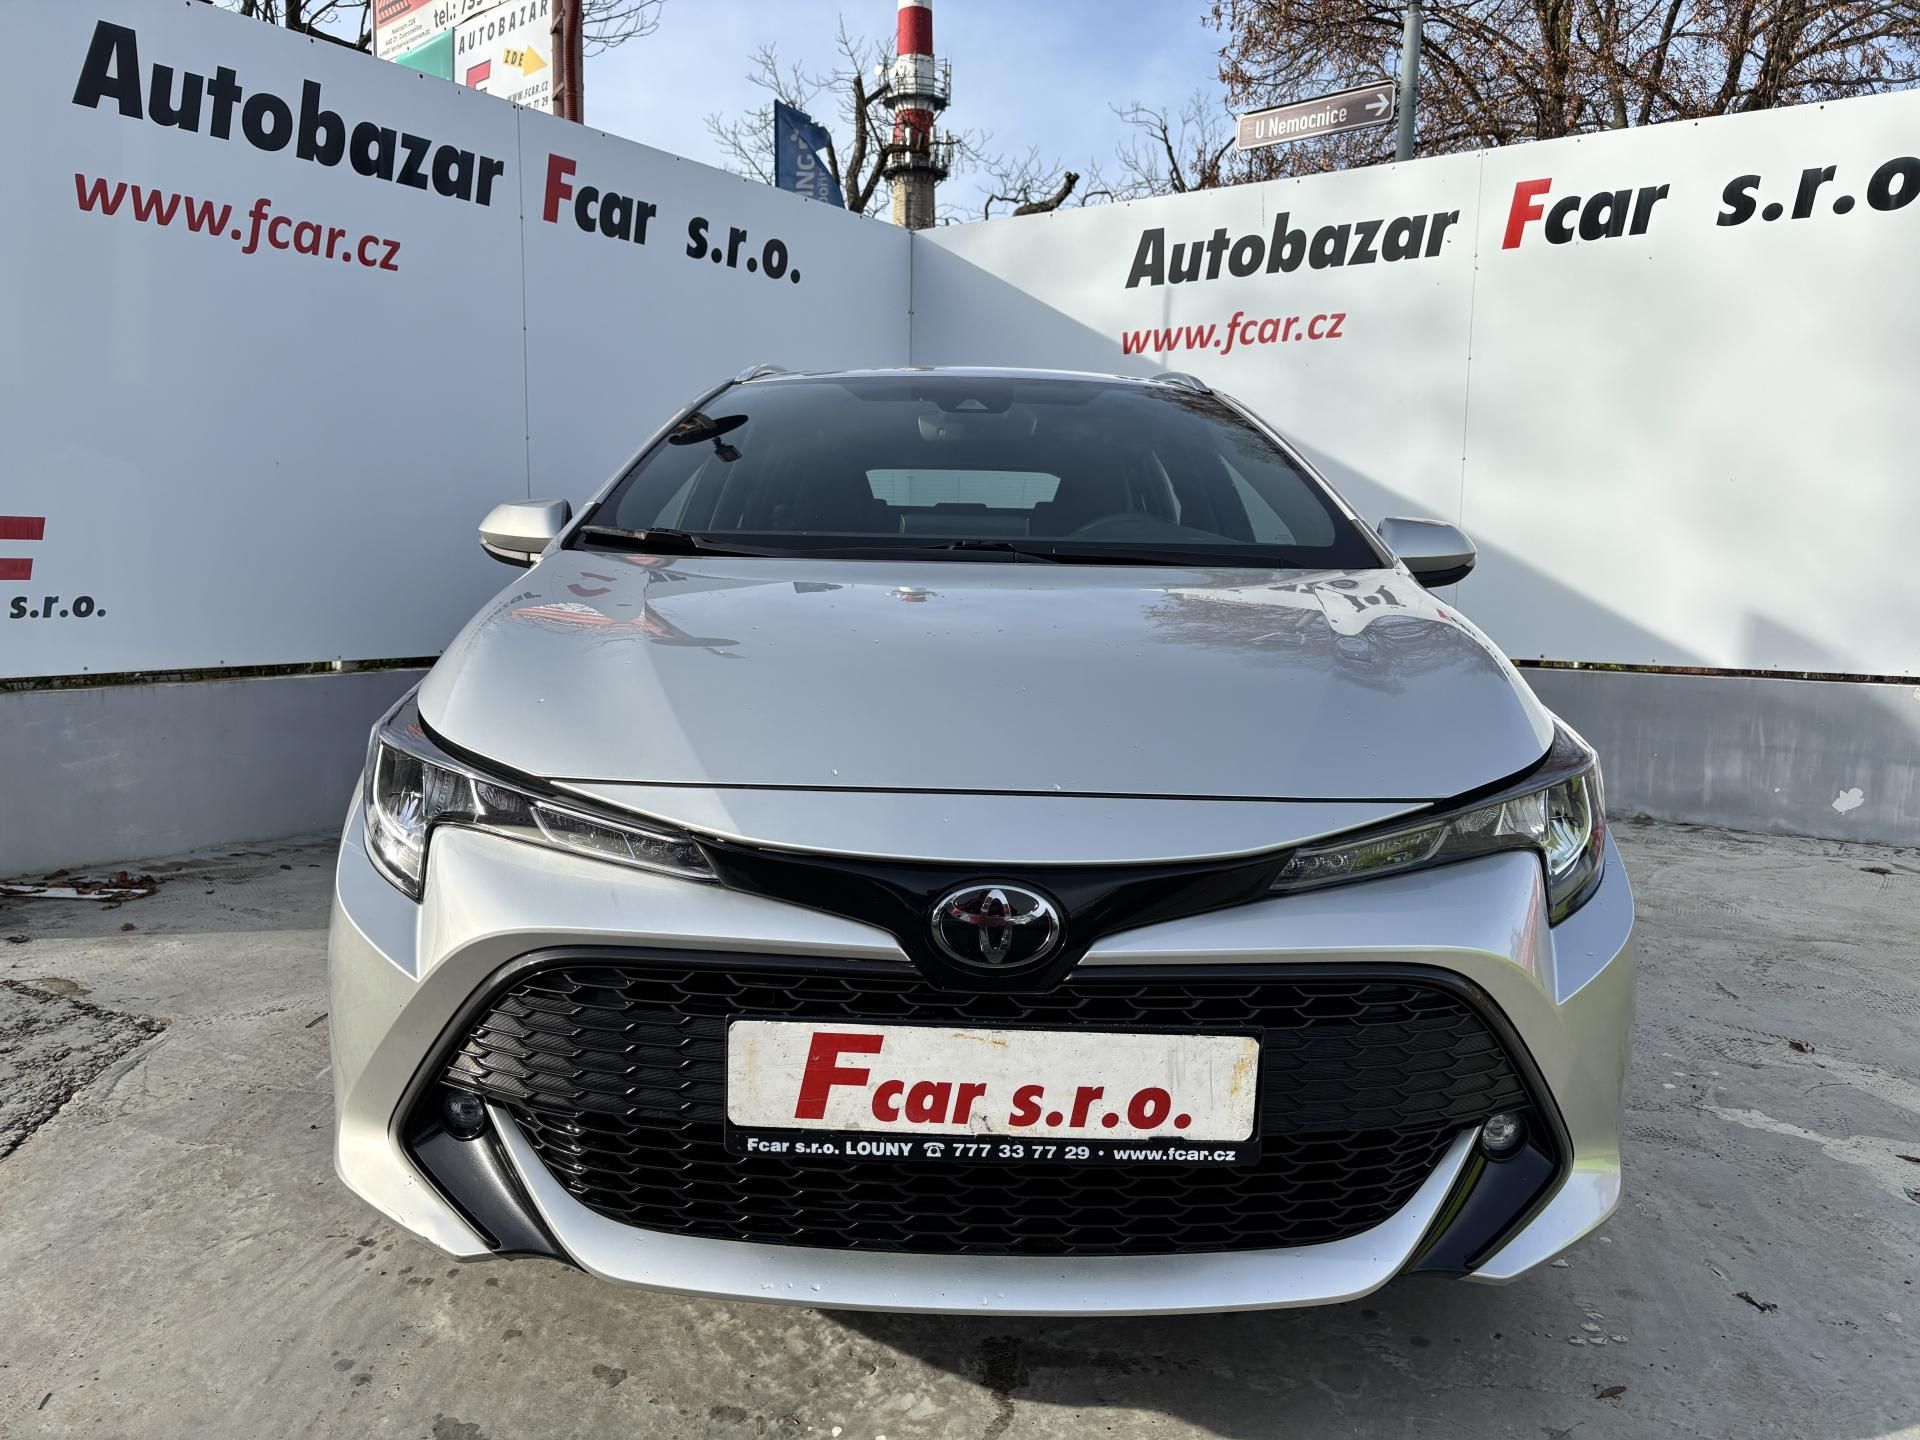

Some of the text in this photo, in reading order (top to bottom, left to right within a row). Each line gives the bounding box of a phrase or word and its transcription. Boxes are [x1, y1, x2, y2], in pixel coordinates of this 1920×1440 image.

[458, 0, 548, 55] AUTOBAZAR
[504, 49, 524, 67] ZDE
[1255, 105, 1347, 139] U Nemocnice
[72, 19, 801, 284] Autobazar Fcar s.r.o.
[74, 173, 401, 272] www.fcar.cz
[1125, 210, 1460, 289] Autobazar
[1502, 177, 1670, 249] Fcar
[1122, 311, 1345, 355] www.fcar.cz
[9, 595, 107, 619] s.r.o.
[1007, 1084, 1192, 1130] s.r.o.
[746, 1137, 1236, 1162] Fcar s.r.o. LOUNY 777 33 77 29 www.fcar.cz
